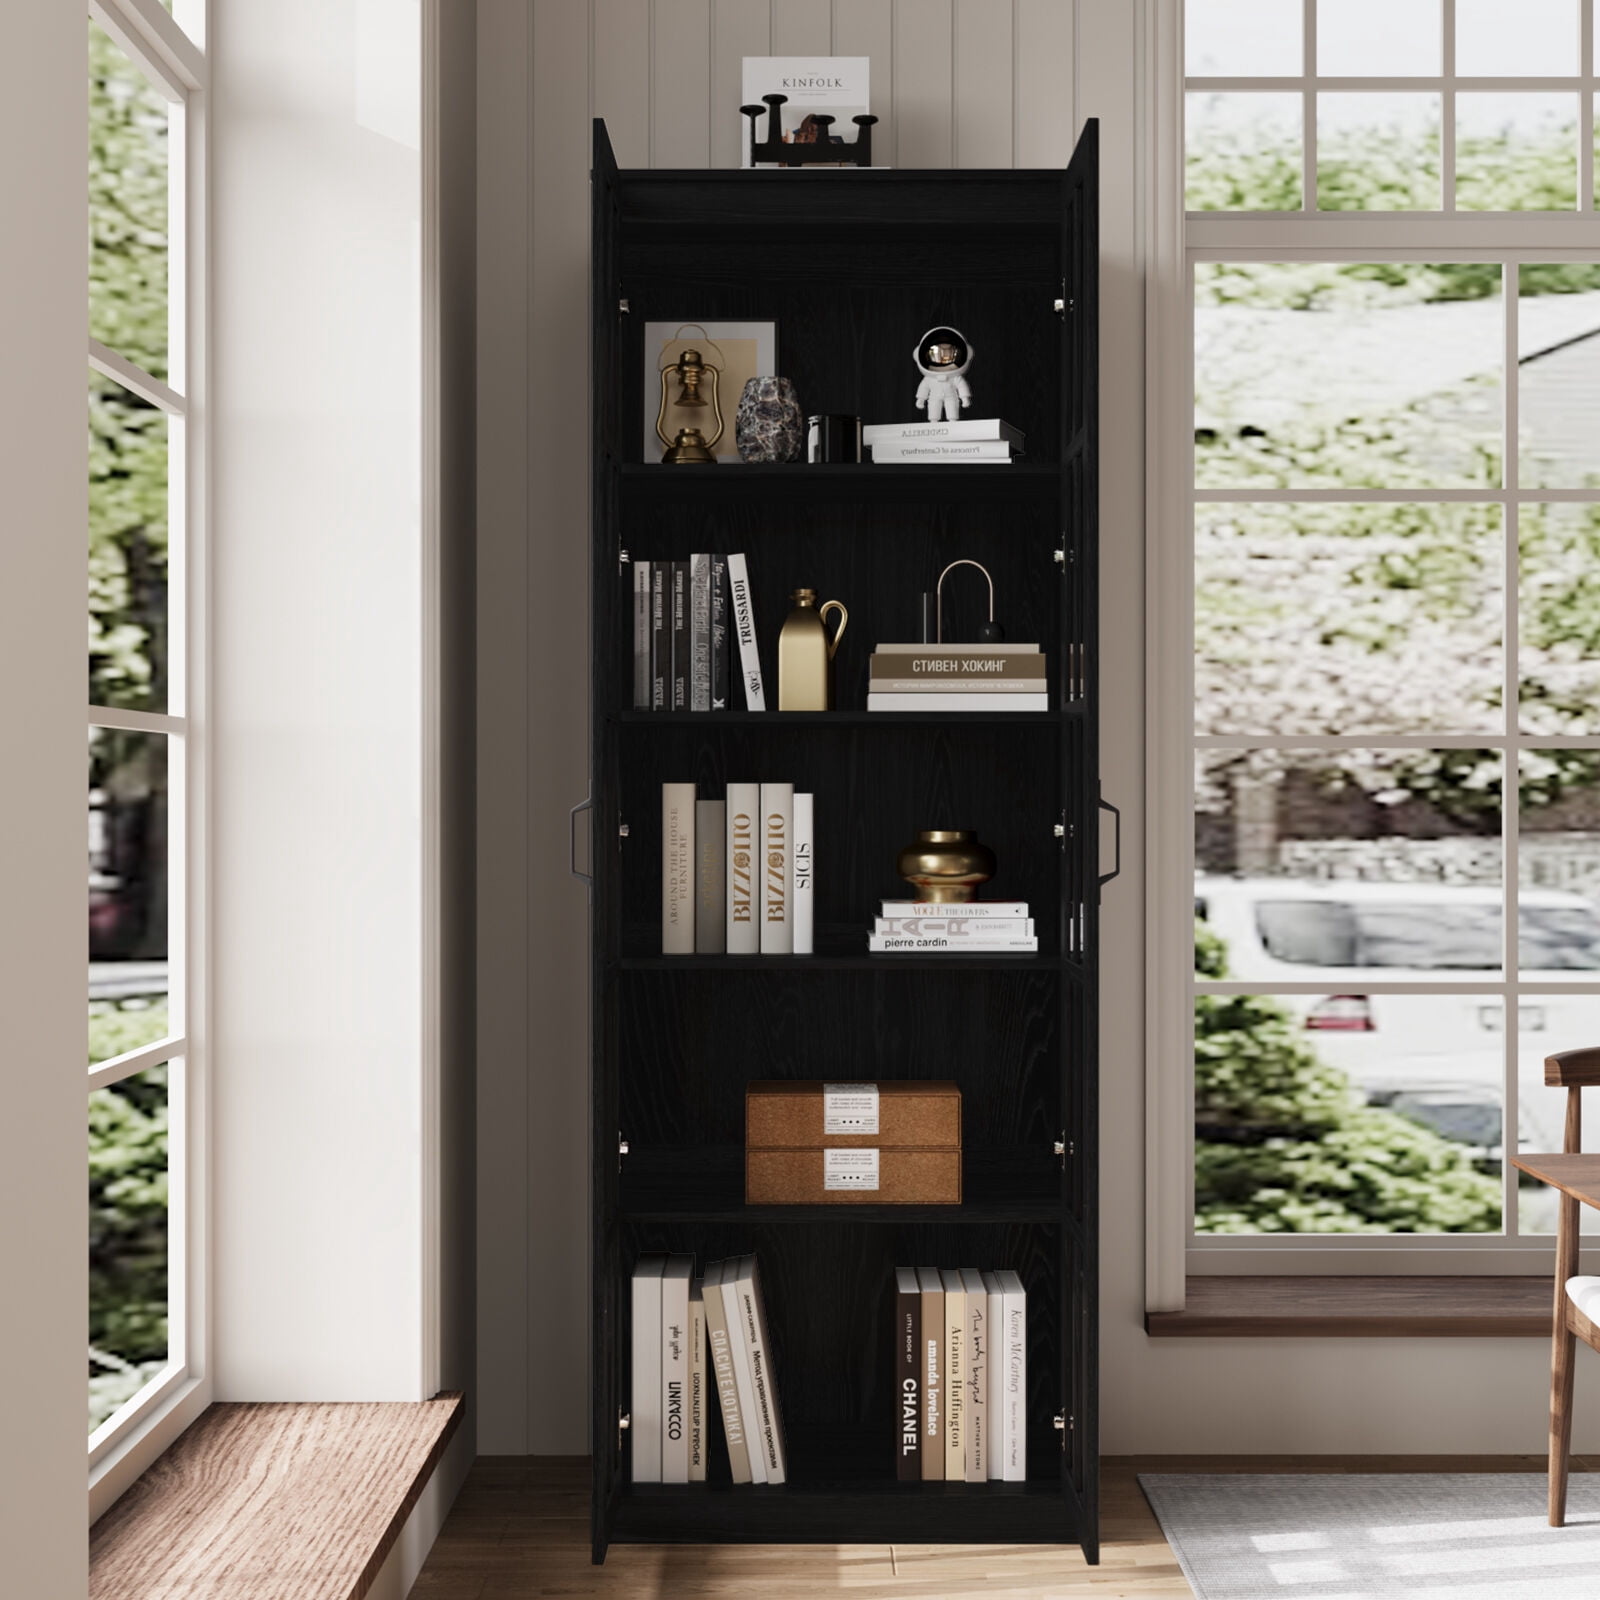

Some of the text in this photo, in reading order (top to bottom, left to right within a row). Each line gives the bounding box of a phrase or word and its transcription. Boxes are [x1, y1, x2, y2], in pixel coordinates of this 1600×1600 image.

[782, 78, 844, 88] KINFOLK
[734, 579, 752, 646] TRUSSARDI
[912, 660, 1006, 672] СТИВЕН ХОКИНГ
[670, 808, 678, 925] AROUND THE HOUSE
[680, 833, 688, 900] FURNITURE
[796, 842, 810, 889] SICIS
[881, 918, 969, 936] HAIR
[884, 938, 914, 949] pierre
[916, 937, 947, 947] cardin
[967, 1309, 984, 1405] The body beyond
[1011, 1309, 1022, 1338] Karen
[713, 1329, 743, 1445] СПАСИТЕ КОТИКА!
[906, 1354, 912, 1363] OF
[928, 1339, 939, 1436] amanda lovelace
[949, 1326, 963, 1448] Arianna Huffington
[1008, 1341, 1022, 1394] McCartney
[752, 1350, 777, 1469] Метод управления проектами
[903, 1378, 917, 1456] CHANEL
